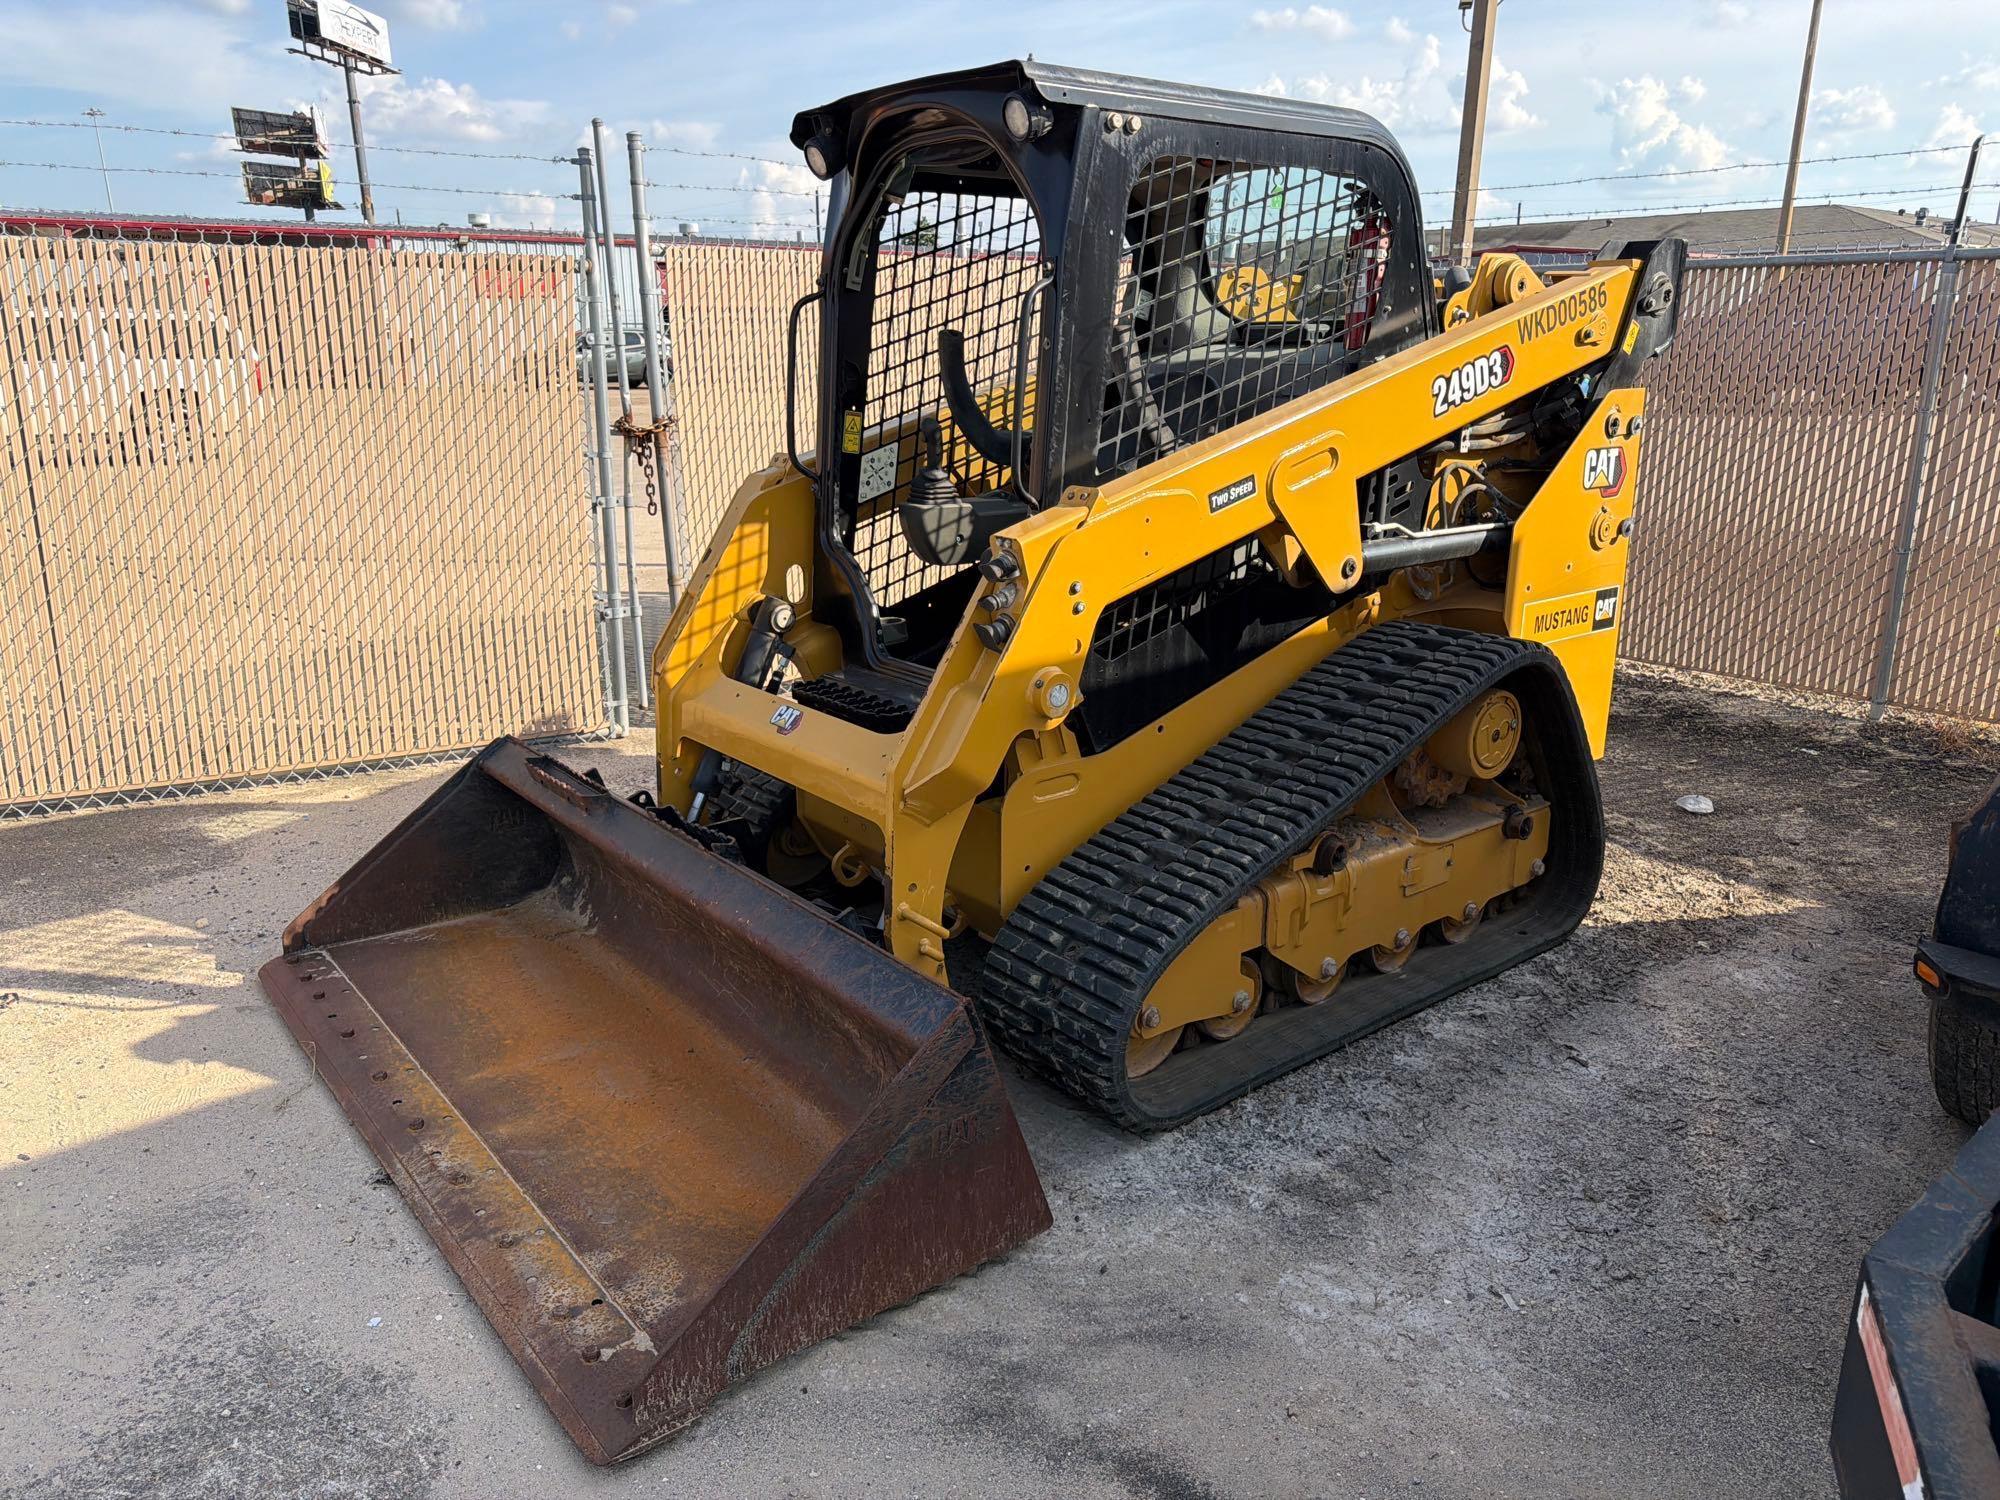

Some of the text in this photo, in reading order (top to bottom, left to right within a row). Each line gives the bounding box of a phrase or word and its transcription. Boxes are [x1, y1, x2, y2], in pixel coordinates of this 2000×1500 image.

[1517, 282, 1608, 345] WKD00586
[1432, 350, 1503, 417] 249D3
[1583, 448, 1619, 489] CAT
[1534, 597, 1617, 634] MUSTANG CAT
[770, 705, 801, 730] CAT
